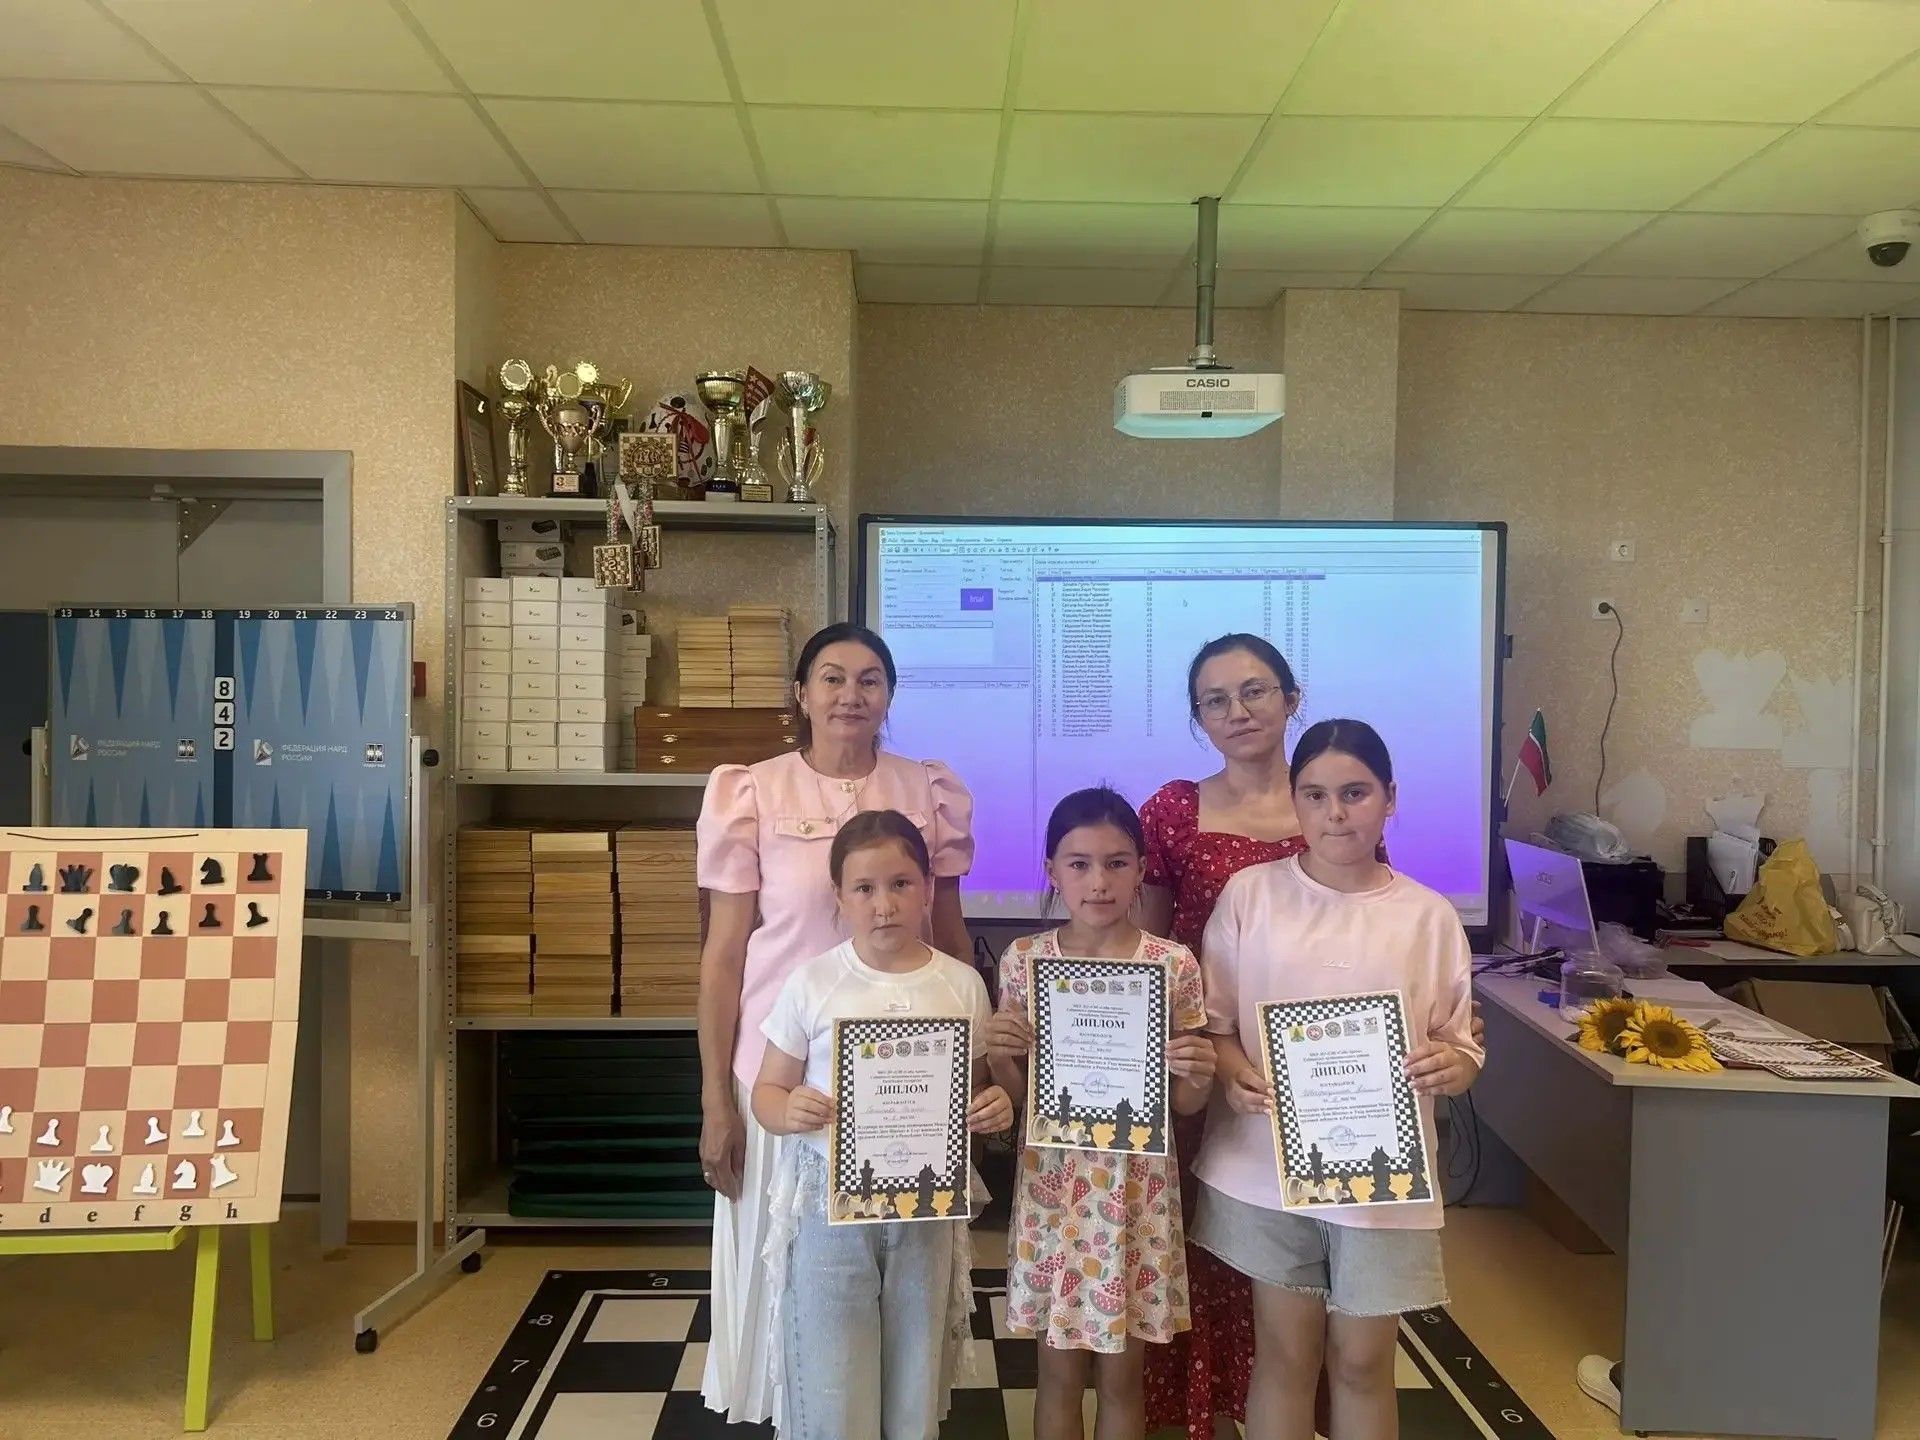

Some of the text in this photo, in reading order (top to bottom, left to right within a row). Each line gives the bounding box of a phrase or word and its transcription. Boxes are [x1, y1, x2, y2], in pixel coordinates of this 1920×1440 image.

[1186, 378, 1230, 388] CASIO
[61, 608, 213, 619] 13 14 15 16 17 18
[239, 610, 397, 620] 19 20 21 22 23 24
[219, 680, 230, 696] 8
[218, 706, 230, 721] 4
[219, 731, 229, 747] 2
[281, 753, 313, 761] РОССИИ
[325, 890, 392, 901] 3 2 1
[1071, 1017, 1125, 1029] ДИПЛОМ
[1310, 1063, 1366, 1079] ДИПЛОМ
[875, 1084, 929, 1096] ДИПЛОМ
[39, 1203, 238, 1223] d e f g h
[652, 1276, 669, 1287] a
[536, 1314, 554, 1326] 8
[510, 1359, 530, 1373] 7
[1455, 1356, 1472, 1370] 7
[476, 1412, 498, 1428] 6
[1501, 1408, 1523, 1424] 6
